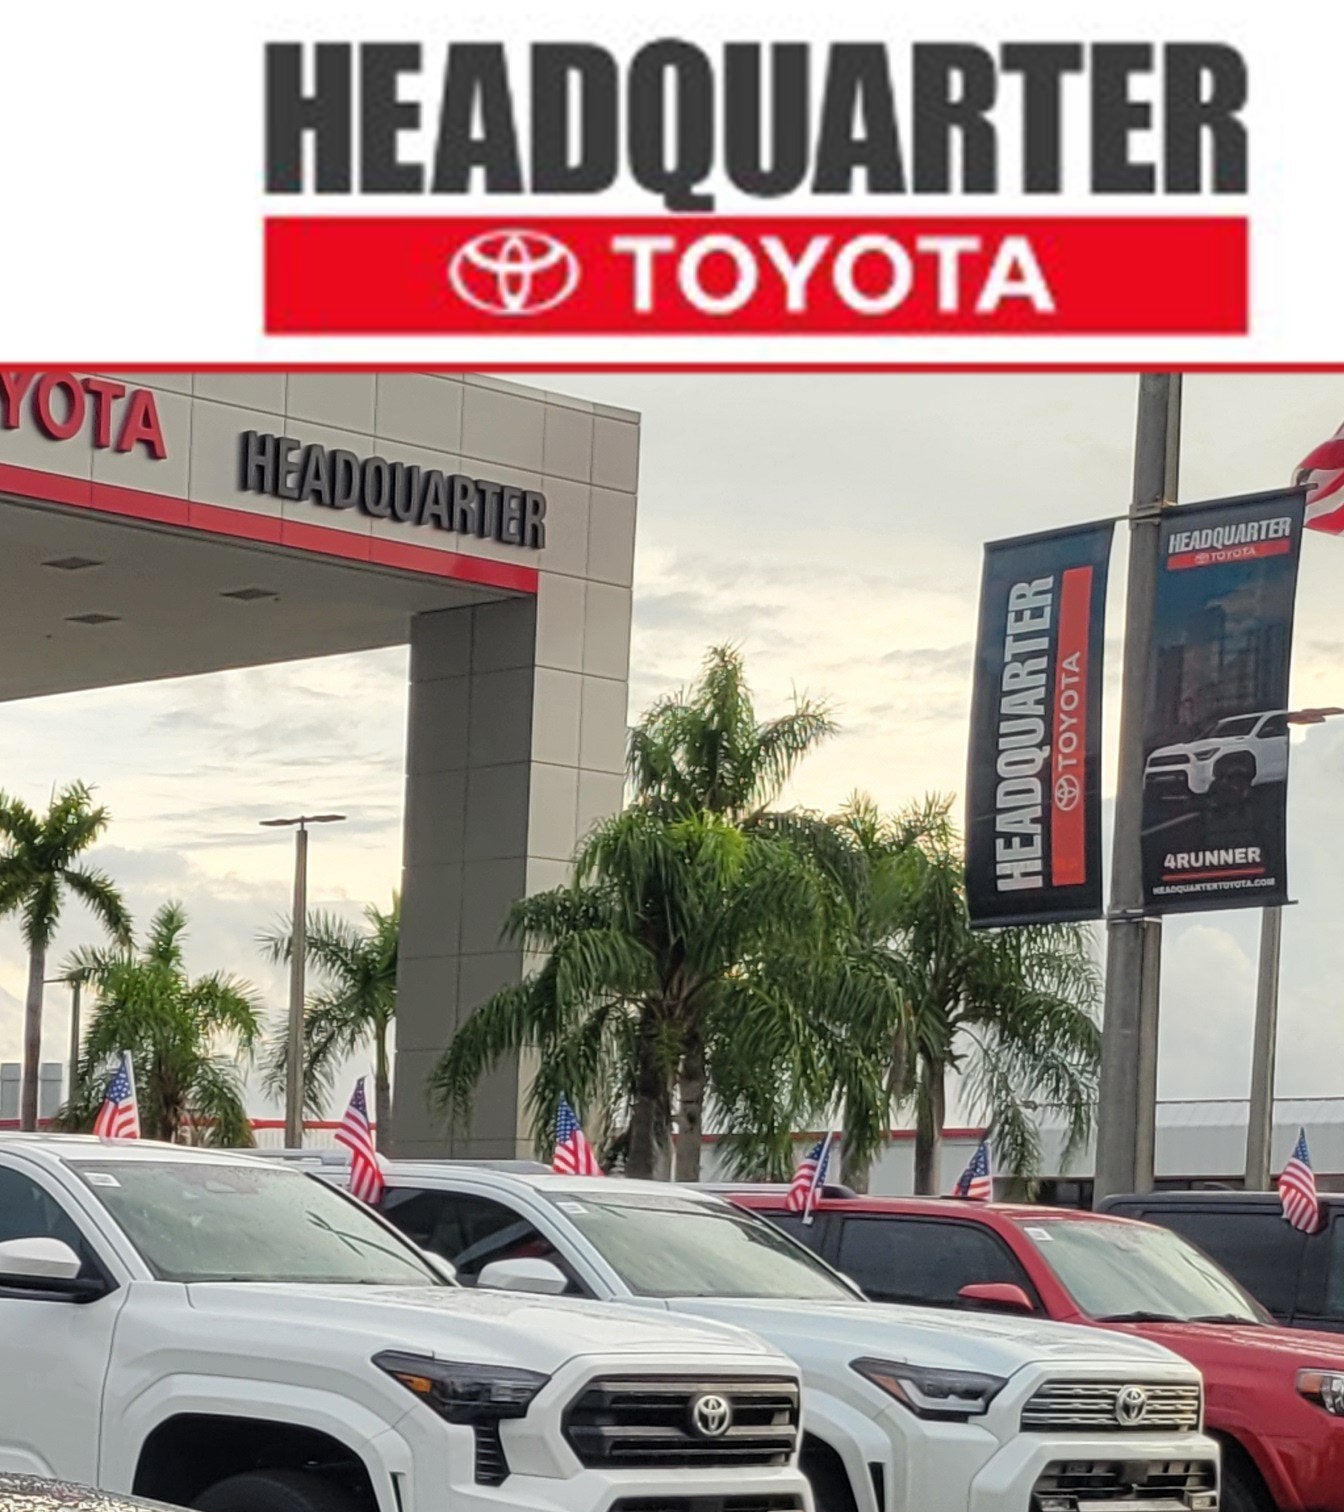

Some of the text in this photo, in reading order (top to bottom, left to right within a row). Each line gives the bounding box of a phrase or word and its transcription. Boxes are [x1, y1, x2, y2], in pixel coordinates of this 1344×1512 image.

[238, 430, 548, 550] HEADQUARTER
[1168, 516, 1292, 554] HEADQUARTER
[1211, 545, 1256, 562] TOYOTA
[1058, 651, 1081, 771] TOYOTA
[995, 575, 1055, 893] HEADQUARTER
[1163, 846, 1262, 870] 4RUNNER
[1152, 877, 1276, 896] HEADQUARTERTOYOTA.COM
